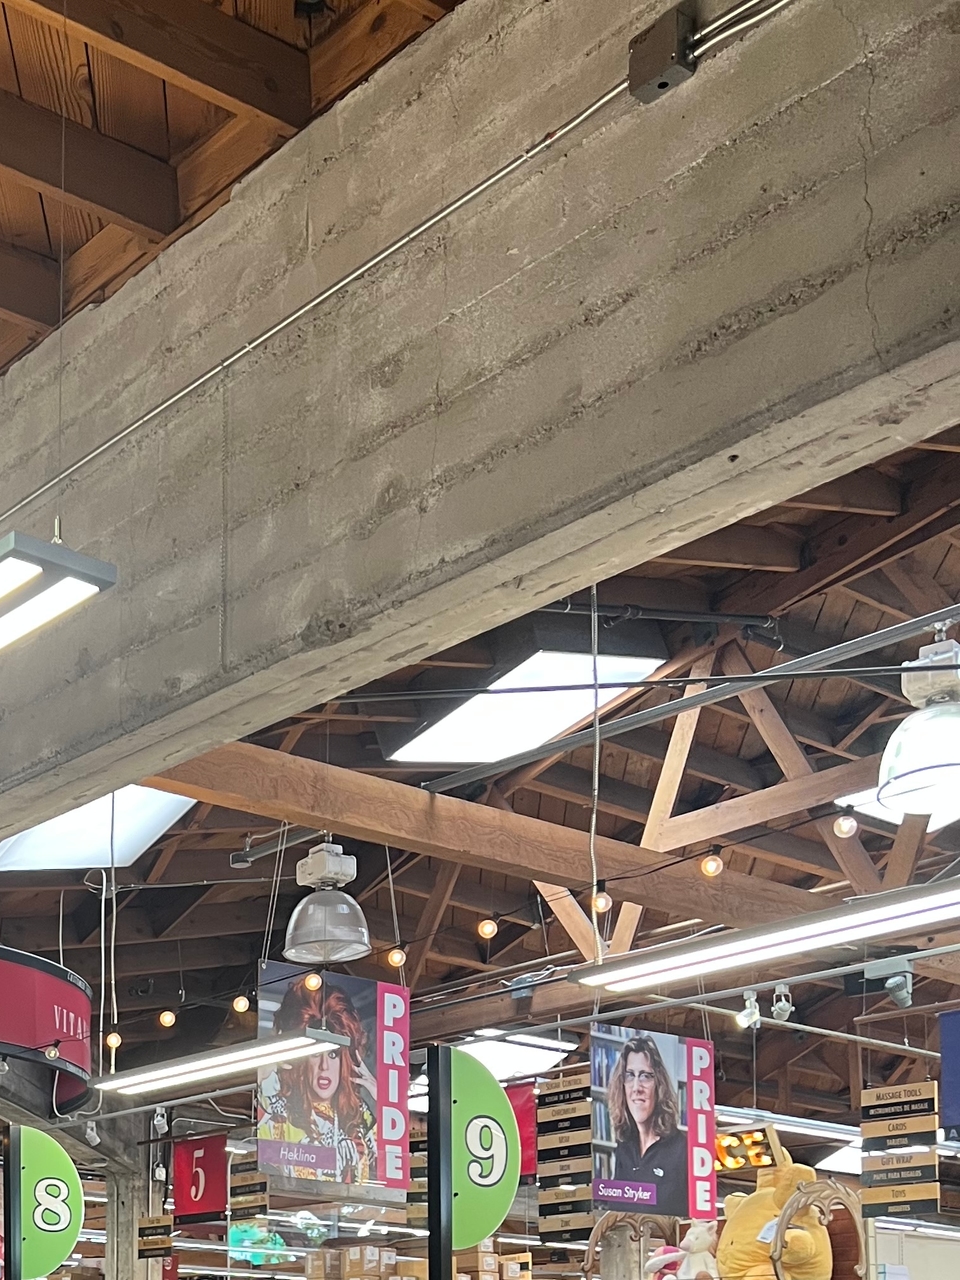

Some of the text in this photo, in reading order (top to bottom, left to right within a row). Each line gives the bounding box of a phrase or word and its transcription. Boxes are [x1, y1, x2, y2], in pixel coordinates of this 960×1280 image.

[382, 992, 406, 1180] PRIDE
[875, 1088, 922, 1101] MASSAGE TOOLS
[280, 1147, 316, 1163] Heklina
[465, 1115, 508, 1187] 9
[692, 1046, 713, 1211] PRIDE
[887, 1123, 907, 1132] CARDS
[190, 1147, 205, 1202] 5
[598, 1184, 651, 1201] Susan Stryker
[33, 1177, 72, 1232] 8
